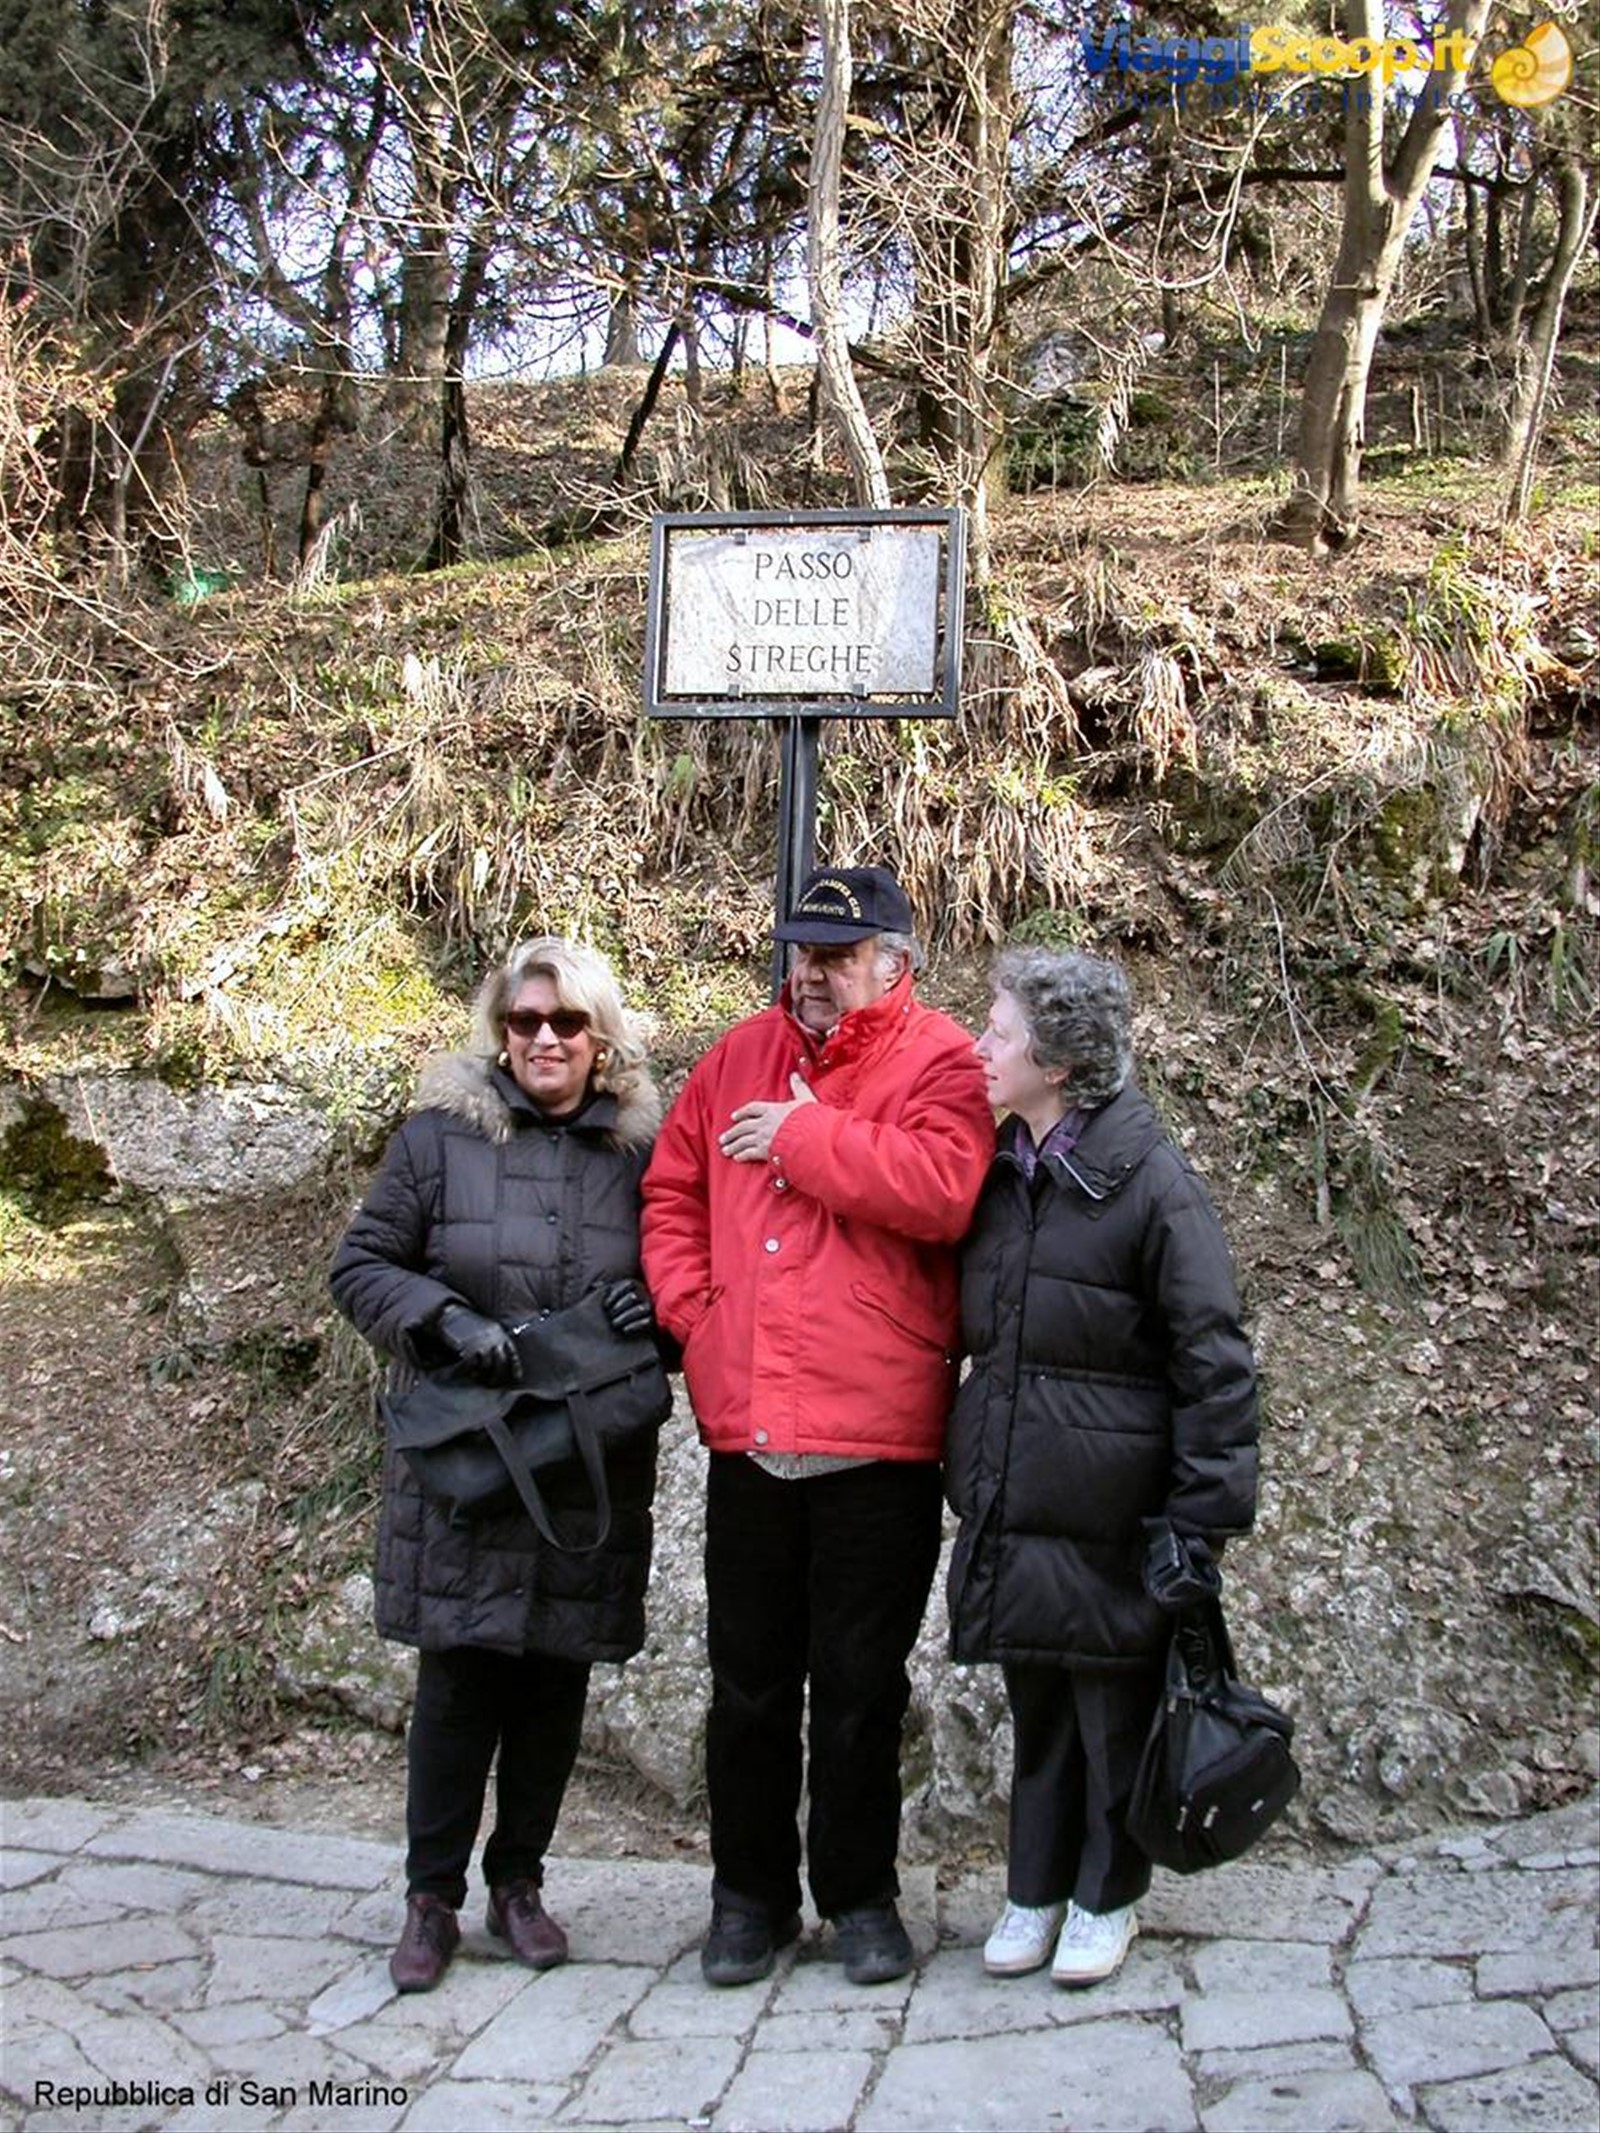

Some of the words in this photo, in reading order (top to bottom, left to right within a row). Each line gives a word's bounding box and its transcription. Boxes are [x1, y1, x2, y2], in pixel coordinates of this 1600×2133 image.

[754, 551, 852, 580] PASSO
[753, 597, 849, 626] DELLE
[726, 644, 872, 674] STREGHE
